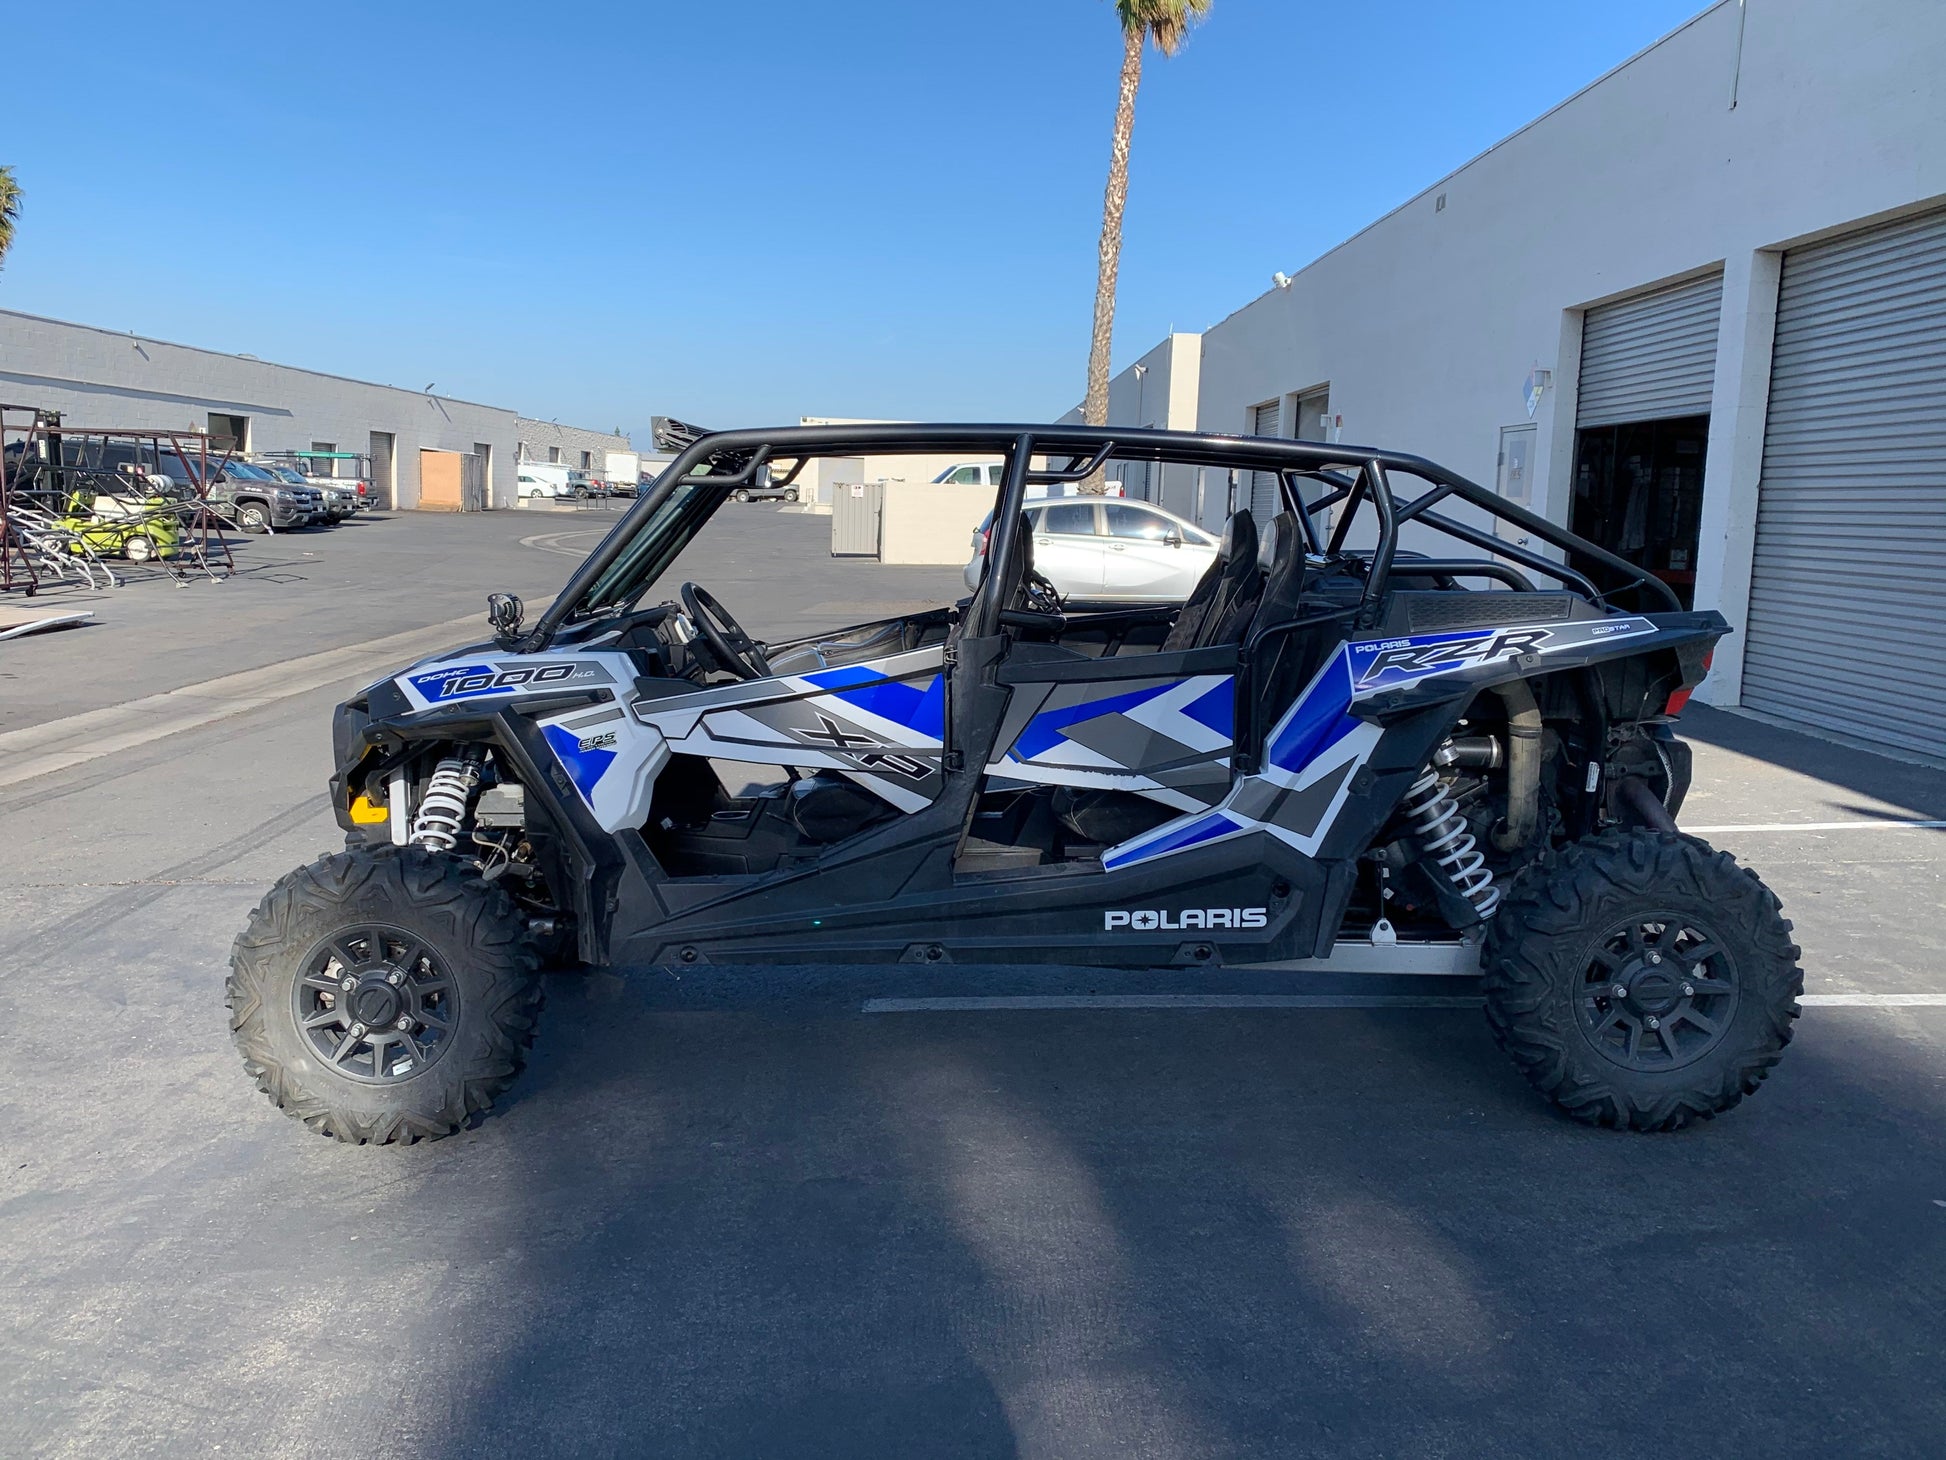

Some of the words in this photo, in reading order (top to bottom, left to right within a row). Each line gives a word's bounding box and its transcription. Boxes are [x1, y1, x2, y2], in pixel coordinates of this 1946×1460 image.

[1355, 639, 1411, 654] POLARIS
[1358, 628, 1555, 685] RZR
[417, 668, 470, 684] DOHC
[440, 663, 577, 698] 1000
[578, 731, 616, 749] EPS
[789, 711, 937, 781] XP
[1104, 907, 1268, 931] POLARIS
